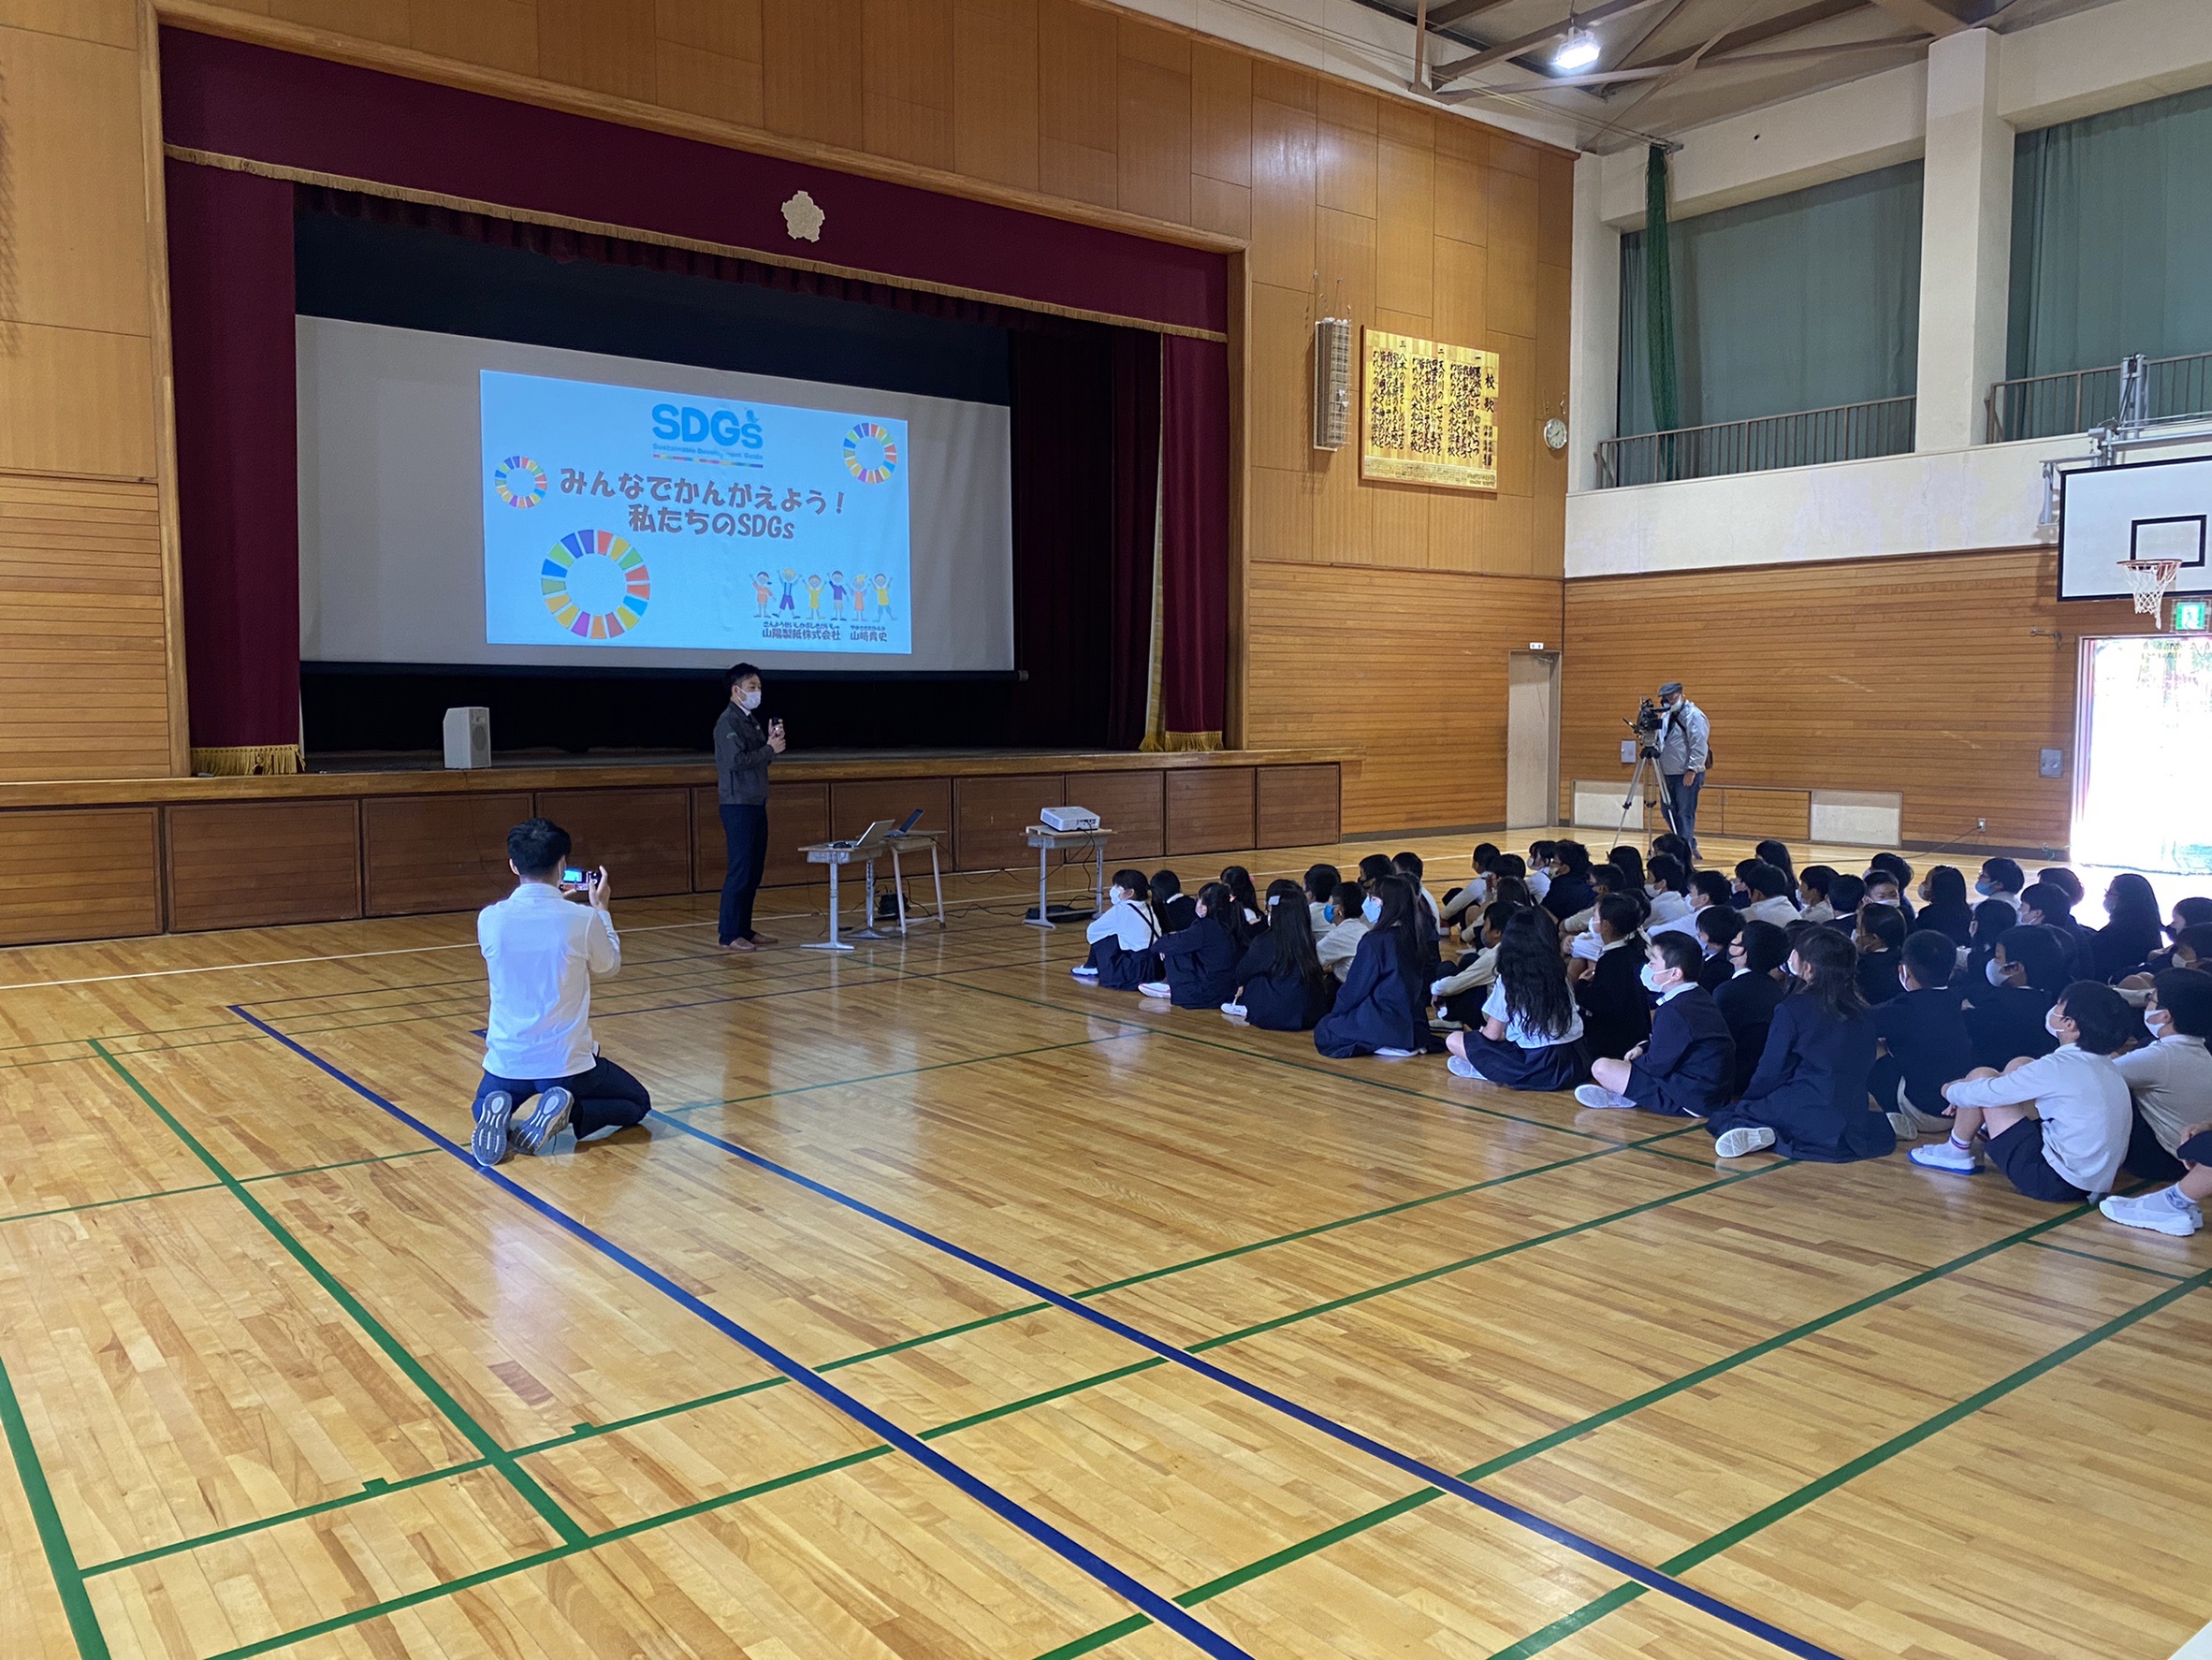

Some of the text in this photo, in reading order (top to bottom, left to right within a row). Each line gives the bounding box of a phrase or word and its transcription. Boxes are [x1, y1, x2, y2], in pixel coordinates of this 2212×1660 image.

[1485, 374, 1495, 413] 校歌
[651, 403, 764, 449] SDGs
[560, 467, 845, 517] みんなでかんがえよう！
[628, 502, 794, 540] 私たちのSDGs
[762, 628, 841, 641] 山陽製紙株式会社
